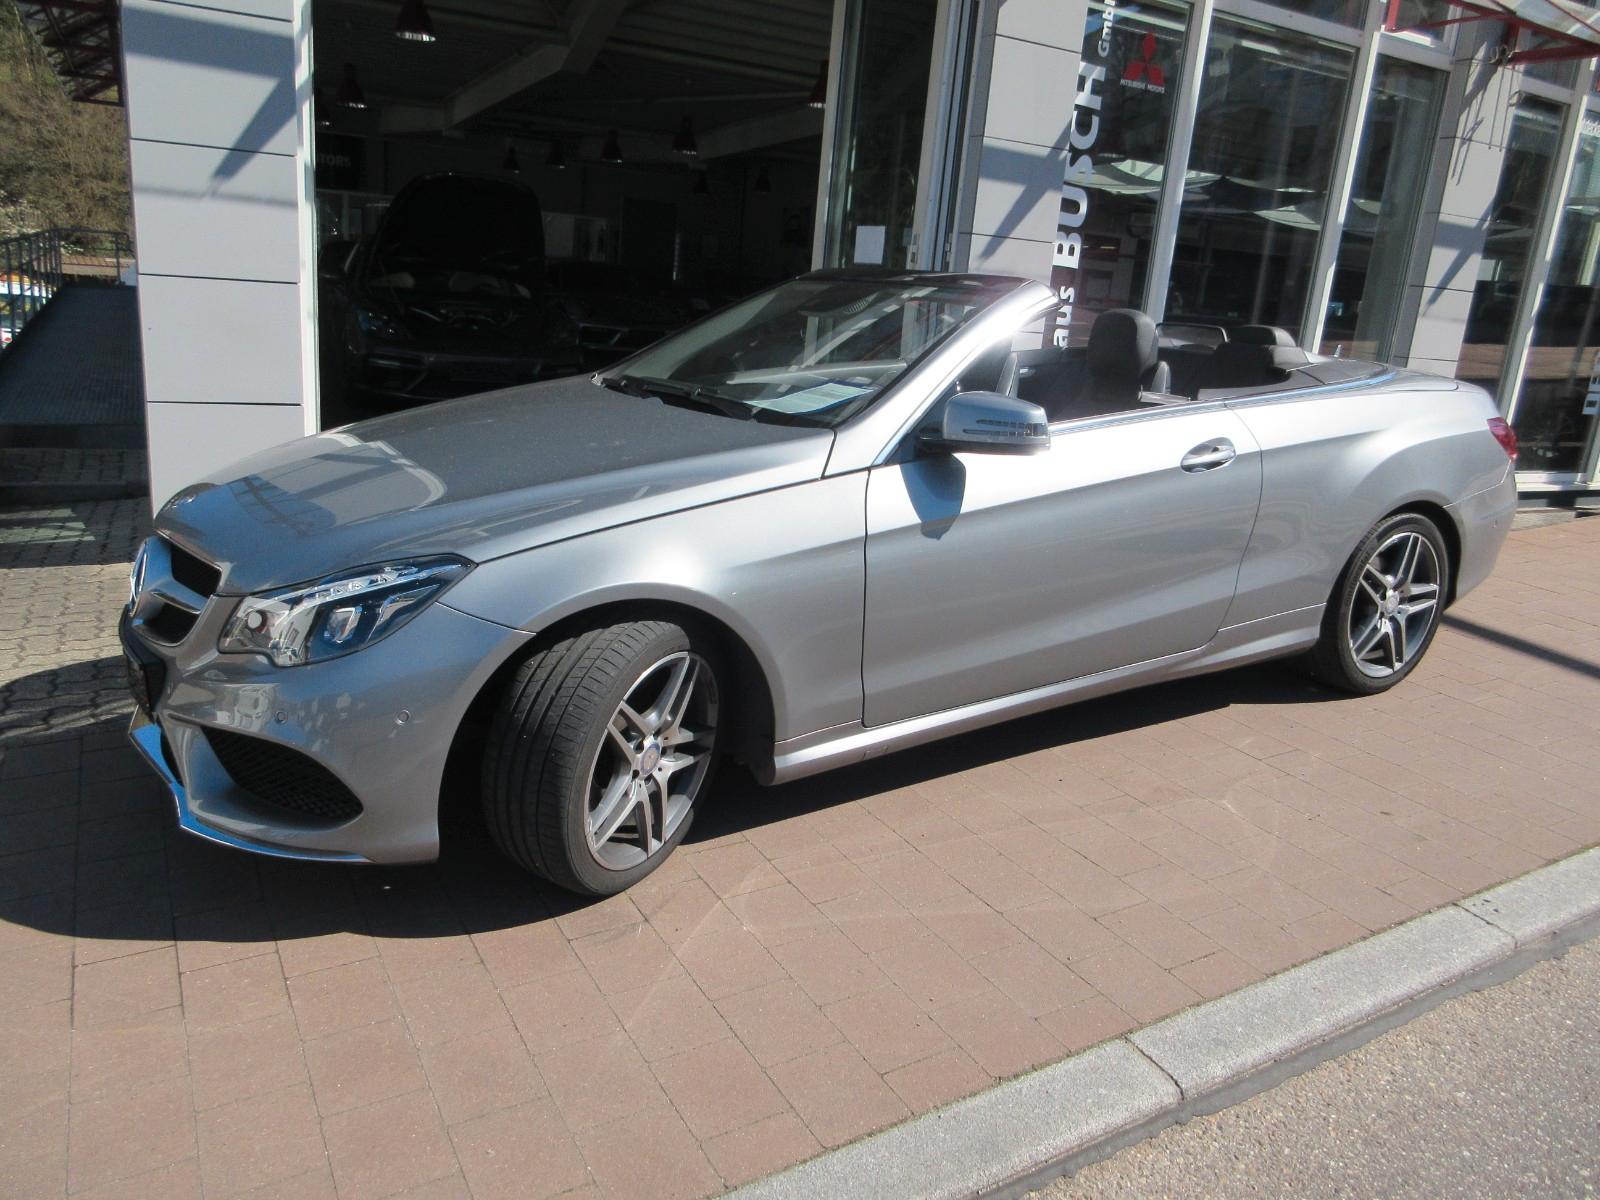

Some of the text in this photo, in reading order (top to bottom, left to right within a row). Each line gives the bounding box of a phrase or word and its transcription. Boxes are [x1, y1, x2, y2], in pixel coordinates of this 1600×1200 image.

[317, 152, 352, 168] TORS
[1053, 61, 1106, 270] BUSCH
[1053, 286, 1075, 348] aus
